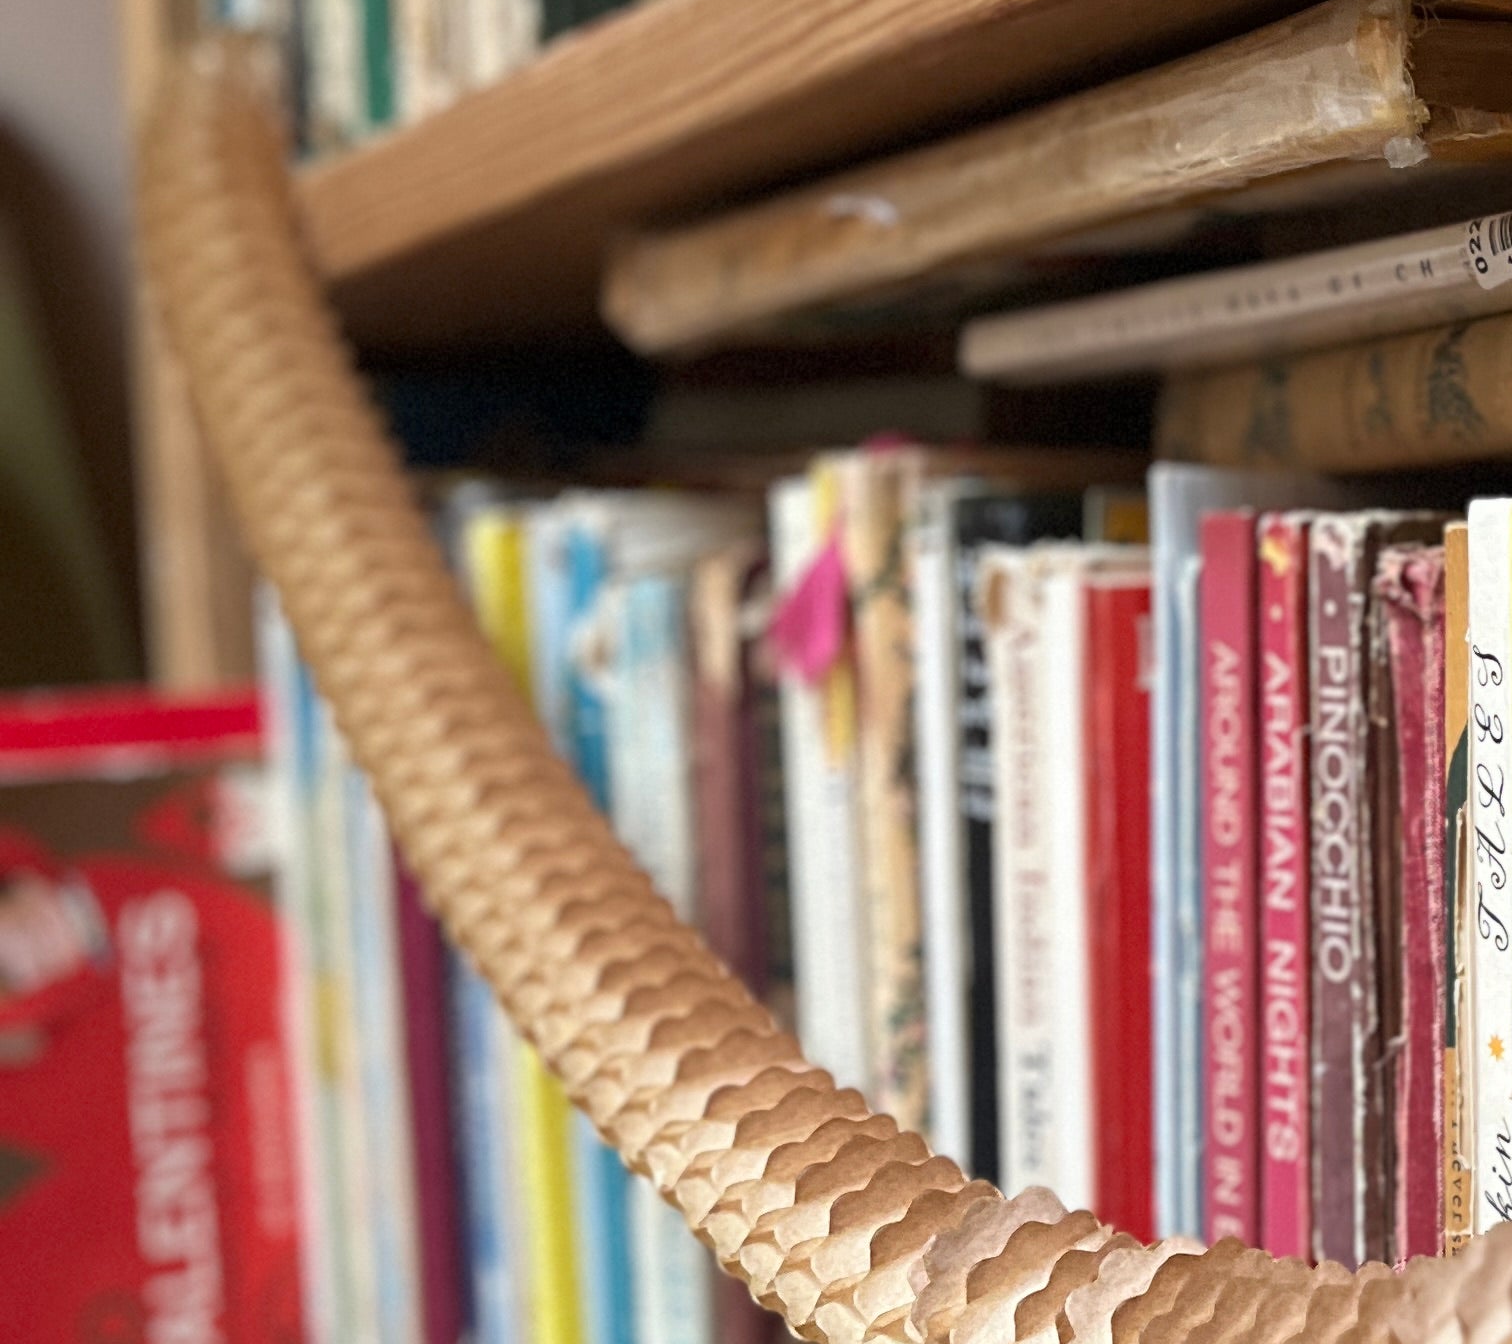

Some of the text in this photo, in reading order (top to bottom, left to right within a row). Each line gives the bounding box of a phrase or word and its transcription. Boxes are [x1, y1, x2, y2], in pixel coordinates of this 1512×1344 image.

[1212, 641, 1242, 846] AROUND
[1319, 646, 1352, 983] PINOCCHIO
[1472, 645, 1508, 954] TALES
[1213, 861, 1241, 952] THE
[1262, 657, 1300, 1163] ARABIAN NIGHTS
[1212, 962, 1244, 1143] WORLD
